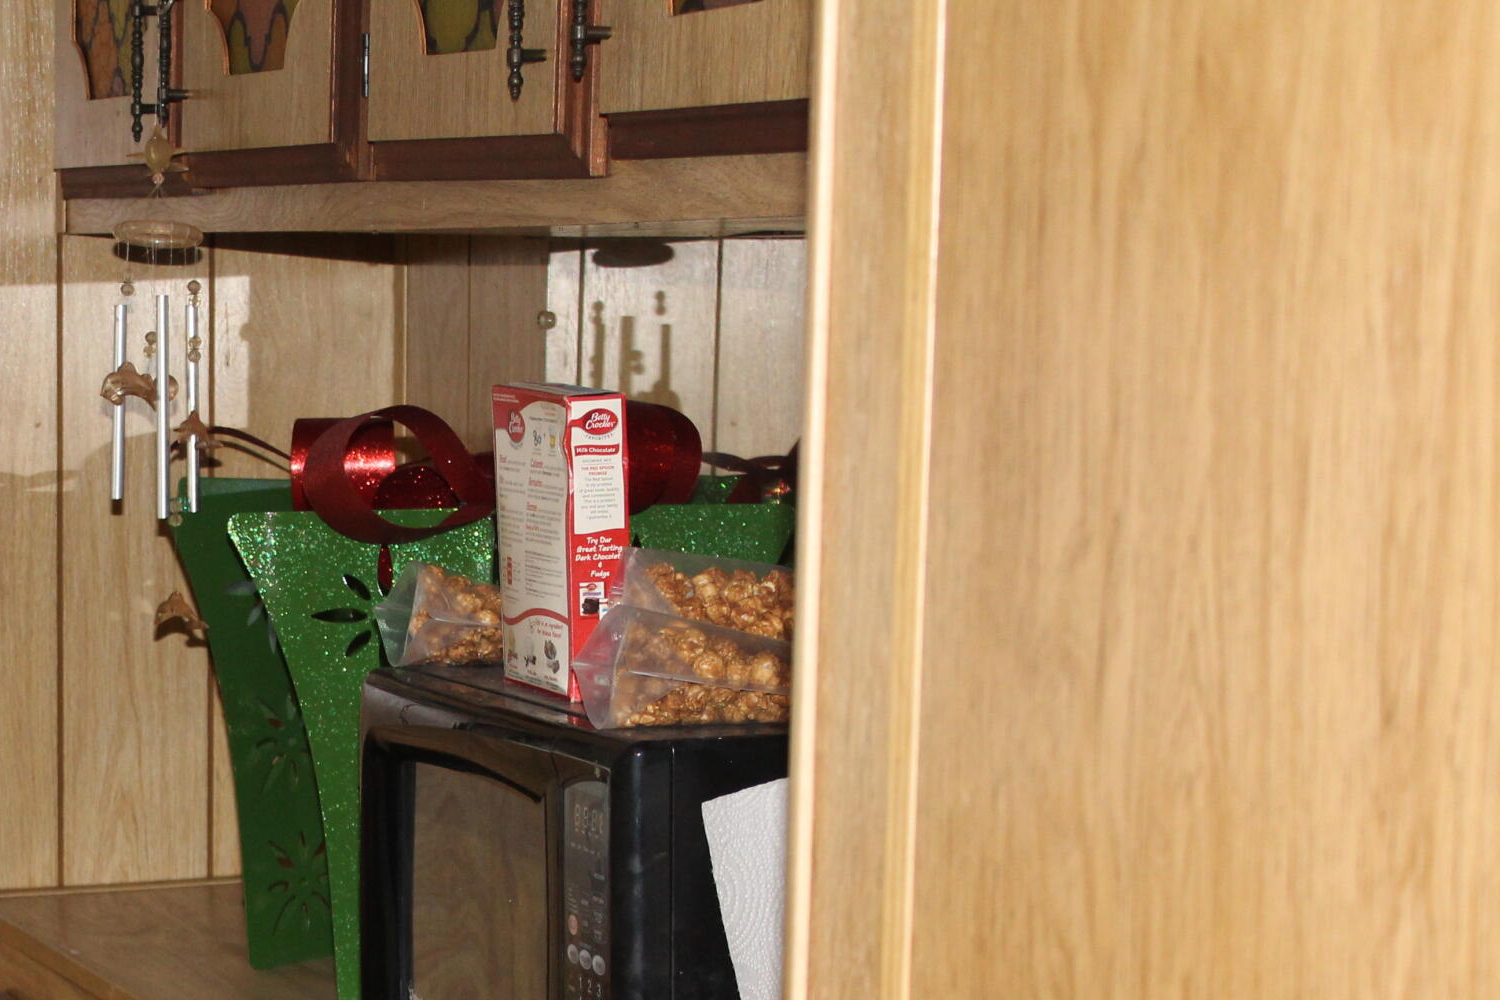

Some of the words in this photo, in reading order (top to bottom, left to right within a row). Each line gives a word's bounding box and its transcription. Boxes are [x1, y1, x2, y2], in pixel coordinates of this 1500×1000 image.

[591, 412, 611, 422] Betty
[585, 419, 615, 430] Crocker
[586, 536, 598, 545] Try
[576, 545, 597, 553] Great
[597, 544, 623, 553] Tasting
[575, 553, 591, 562] Dark
[590, 570, 610, 579] Fudge
